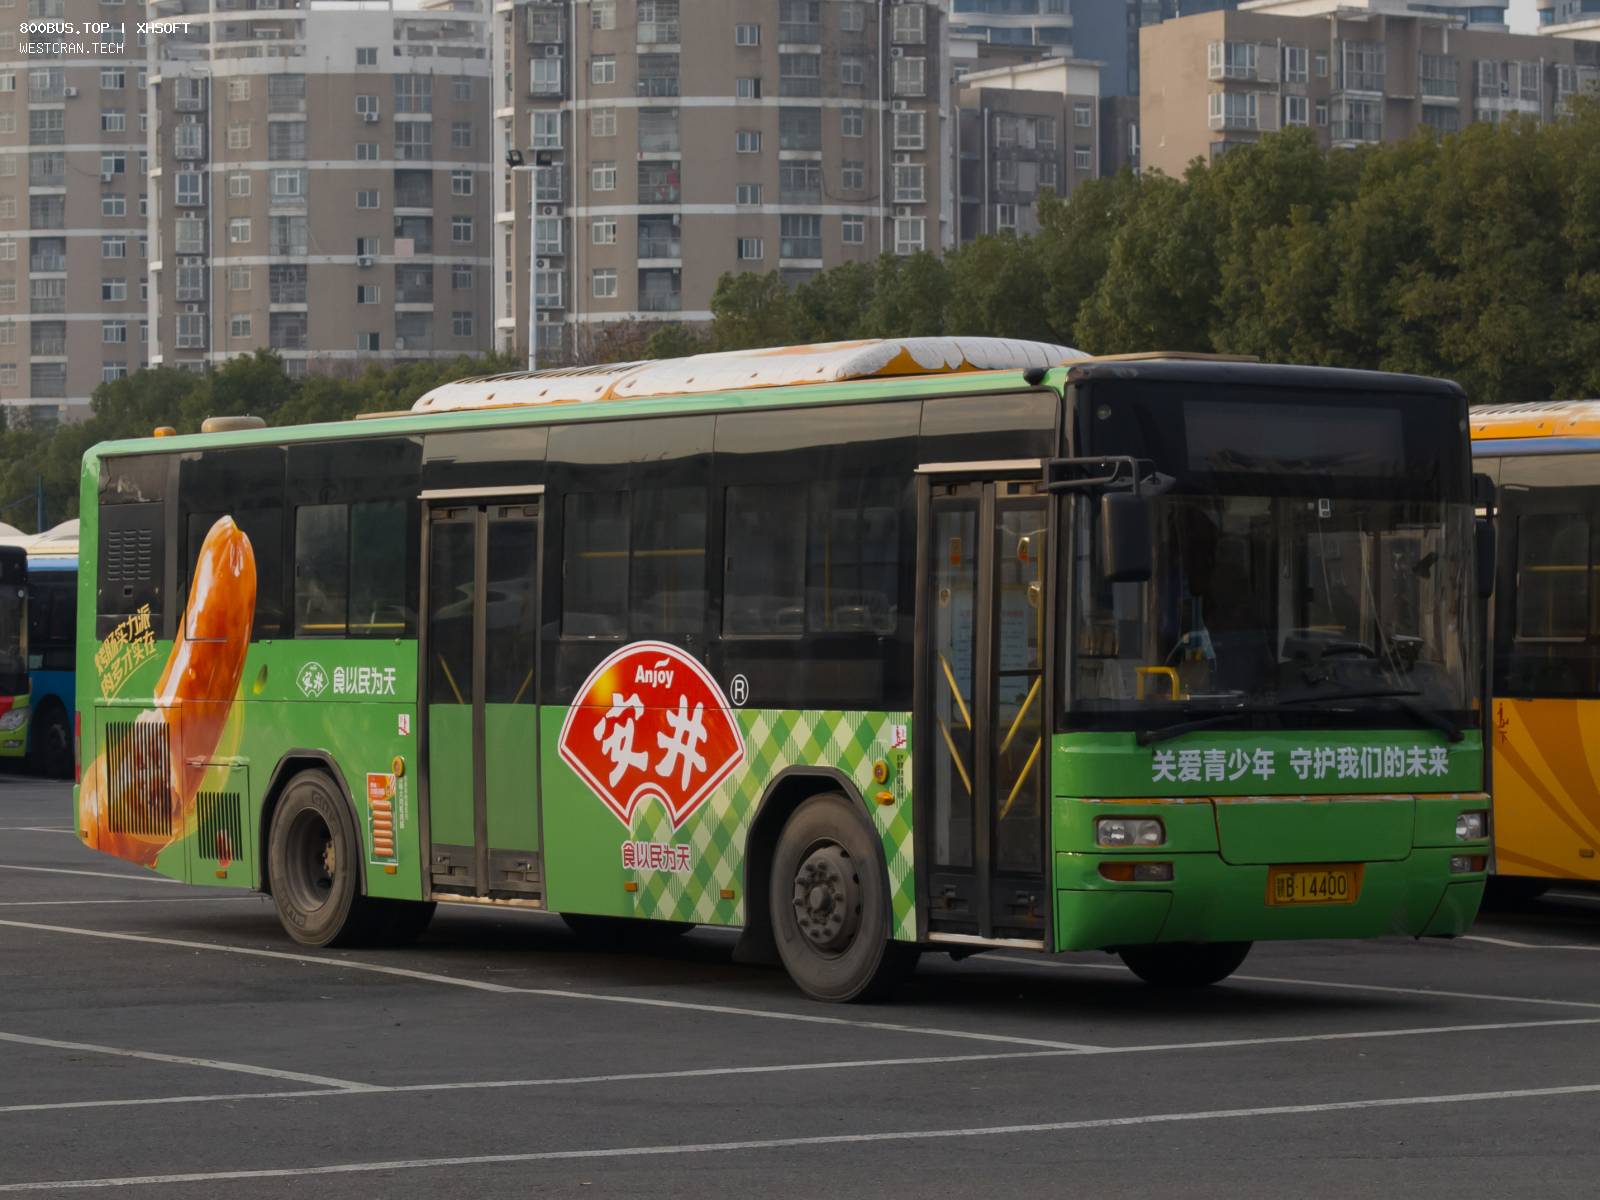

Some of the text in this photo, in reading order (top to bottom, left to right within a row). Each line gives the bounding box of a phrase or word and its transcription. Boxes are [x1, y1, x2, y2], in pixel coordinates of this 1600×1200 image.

[332, 666, 397, 696] 食以民为天
[634, 658, 674, 688] Anjoy
[593, 692, 708, 792] 安井
[1151, 745, 1450, 783] 关爱青少年 守护我们的未来
[621, 841, 692, 873] 食以民为天
